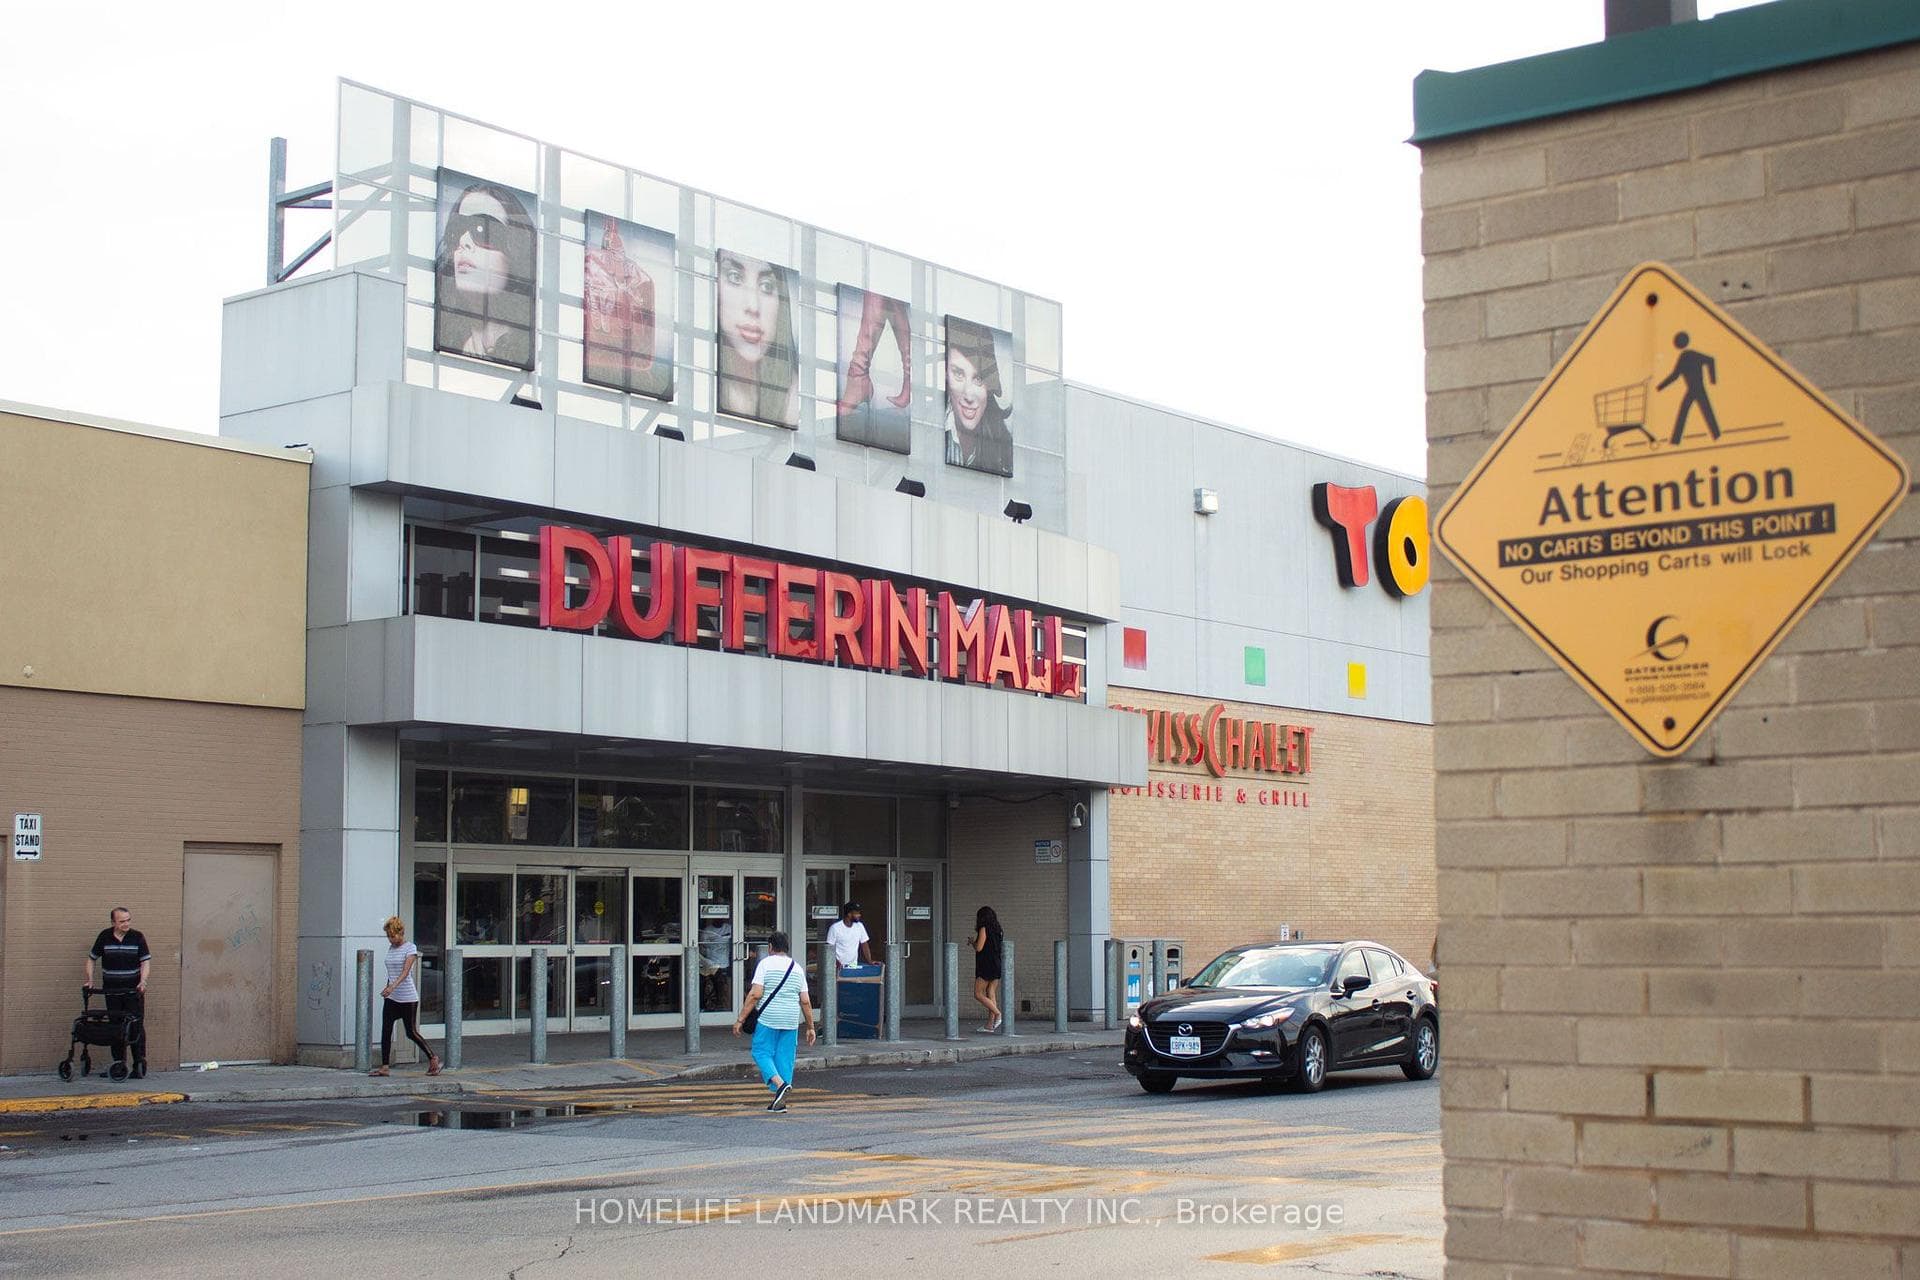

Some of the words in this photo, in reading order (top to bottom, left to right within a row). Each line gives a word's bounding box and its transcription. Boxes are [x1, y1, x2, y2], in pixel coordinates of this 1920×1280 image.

[1538, 465, 1794, 526] Attention
[1504, 542, 1533, 562] NO
[1539, 535, 1603, 558] CARTS
[1610, 525, 1692, 551] BEYOND
[1698, 519, 1745, 541] THIS
[1752, 511, 1814, 536] POINT
[1521, 568, 1554, 585] Our
[1560, 559, 1649, 581] Shopping
[1658, 552, 1711, 571] Carts
[1721, 546, 1752, 565] will
[1762, 541, 1812, 561] Lock
[540, 525, 927, 677] DUFFERIN
[938, 591, 1080, 698] MALL
[1236, 787, 1247, 804] &
[1259, 789, 1310, 808] GRILL
[15, 834, 40, 846] STAND
[19, 818, 37, 830] TAXI
